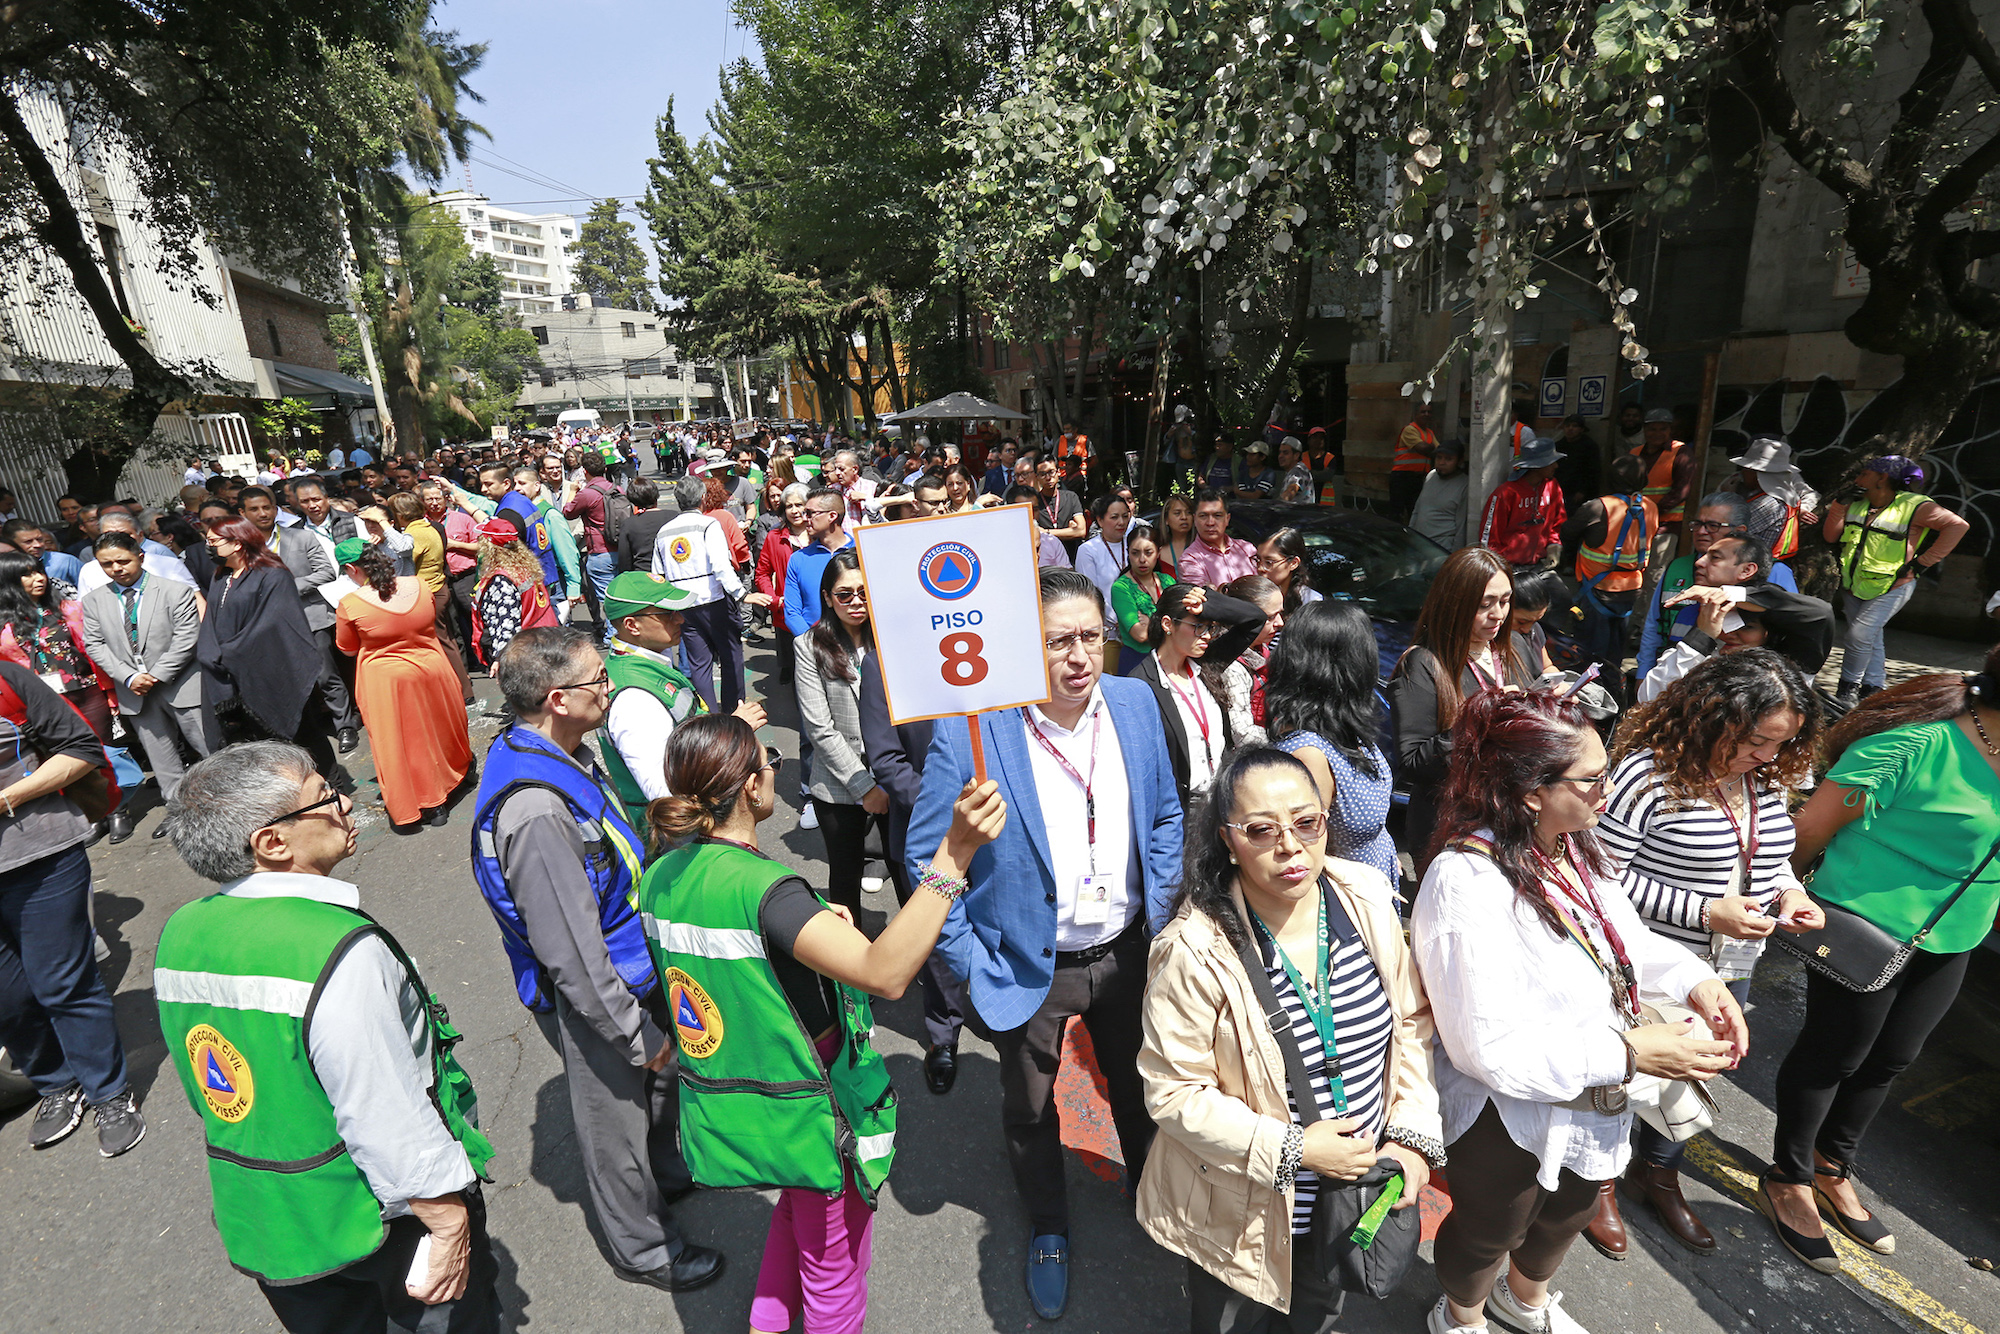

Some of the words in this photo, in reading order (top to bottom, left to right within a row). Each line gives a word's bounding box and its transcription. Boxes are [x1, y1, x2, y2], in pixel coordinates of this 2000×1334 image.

[921, 544, 961, 571] PROTECCIÓN
[961, 547, 978, 565] CIVIL
[930, 609, 984, 631] PISO
[938, 631, 989, 686] 8
[693, 987, 712, 1013] CIVIL
[188, 1030, 219, 1064] PROTECCION
[221, 1045, 242, 1072] CIVIL
